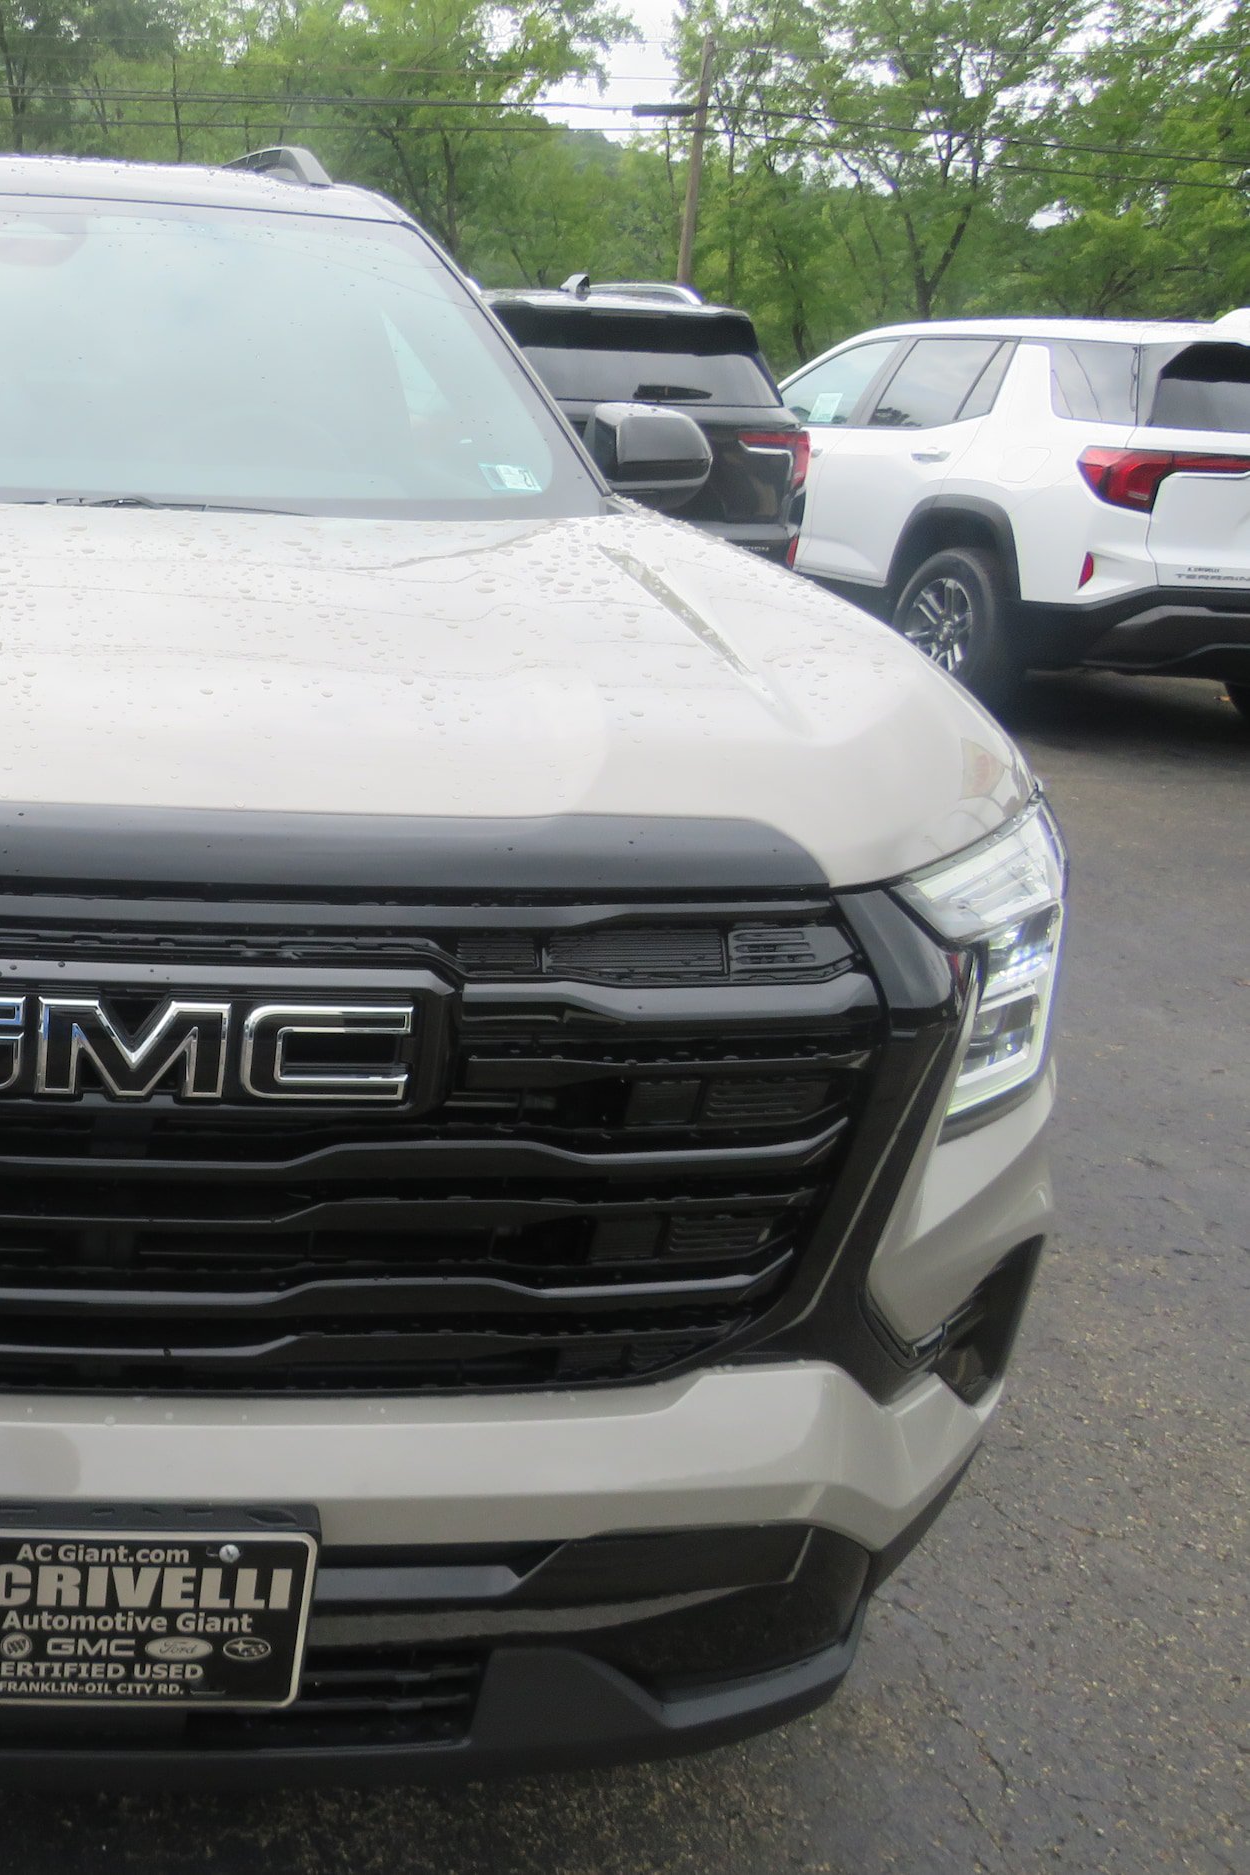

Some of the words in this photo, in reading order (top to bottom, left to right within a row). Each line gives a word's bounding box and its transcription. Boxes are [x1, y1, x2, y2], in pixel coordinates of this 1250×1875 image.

[2, 1609, 168, 1632] Automotive
[176, 1612, 252, 1633] Giant
[46, 1637, 136, 1657] GMC
[158, 1640, 200, 1655] Ford
[134, 1662, 204, 1680] USED
[116, 1682, 154, 1695] CITY
[157, 1682, 184, 1695] RD.
